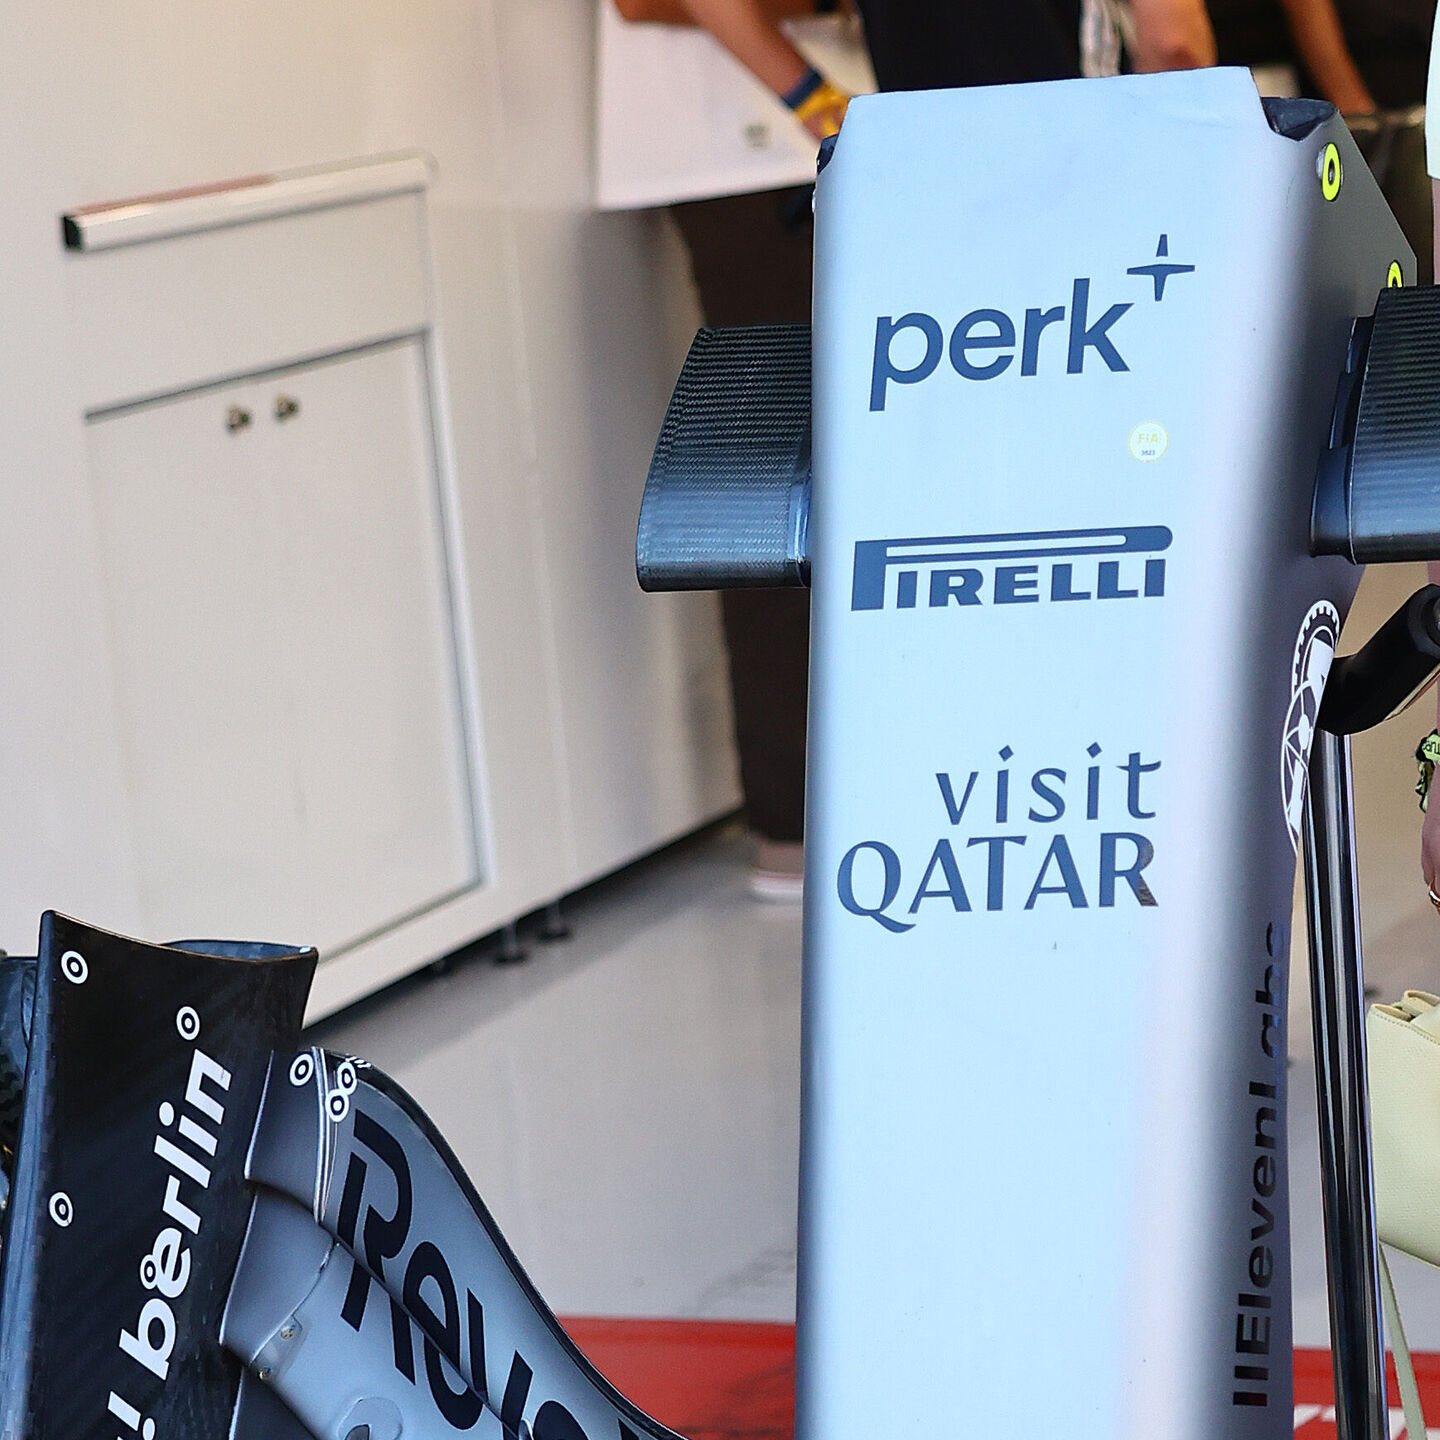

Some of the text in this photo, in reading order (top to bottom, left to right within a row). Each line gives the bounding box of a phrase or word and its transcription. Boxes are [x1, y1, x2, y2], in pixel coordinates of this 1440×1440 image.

[850, 525, 1173, 611] PIRELLI
[935, 742, 1162, 825] visit
[836, 831, 1159, 933] QATAR
[119, 1048, 232, 1381] berlin
